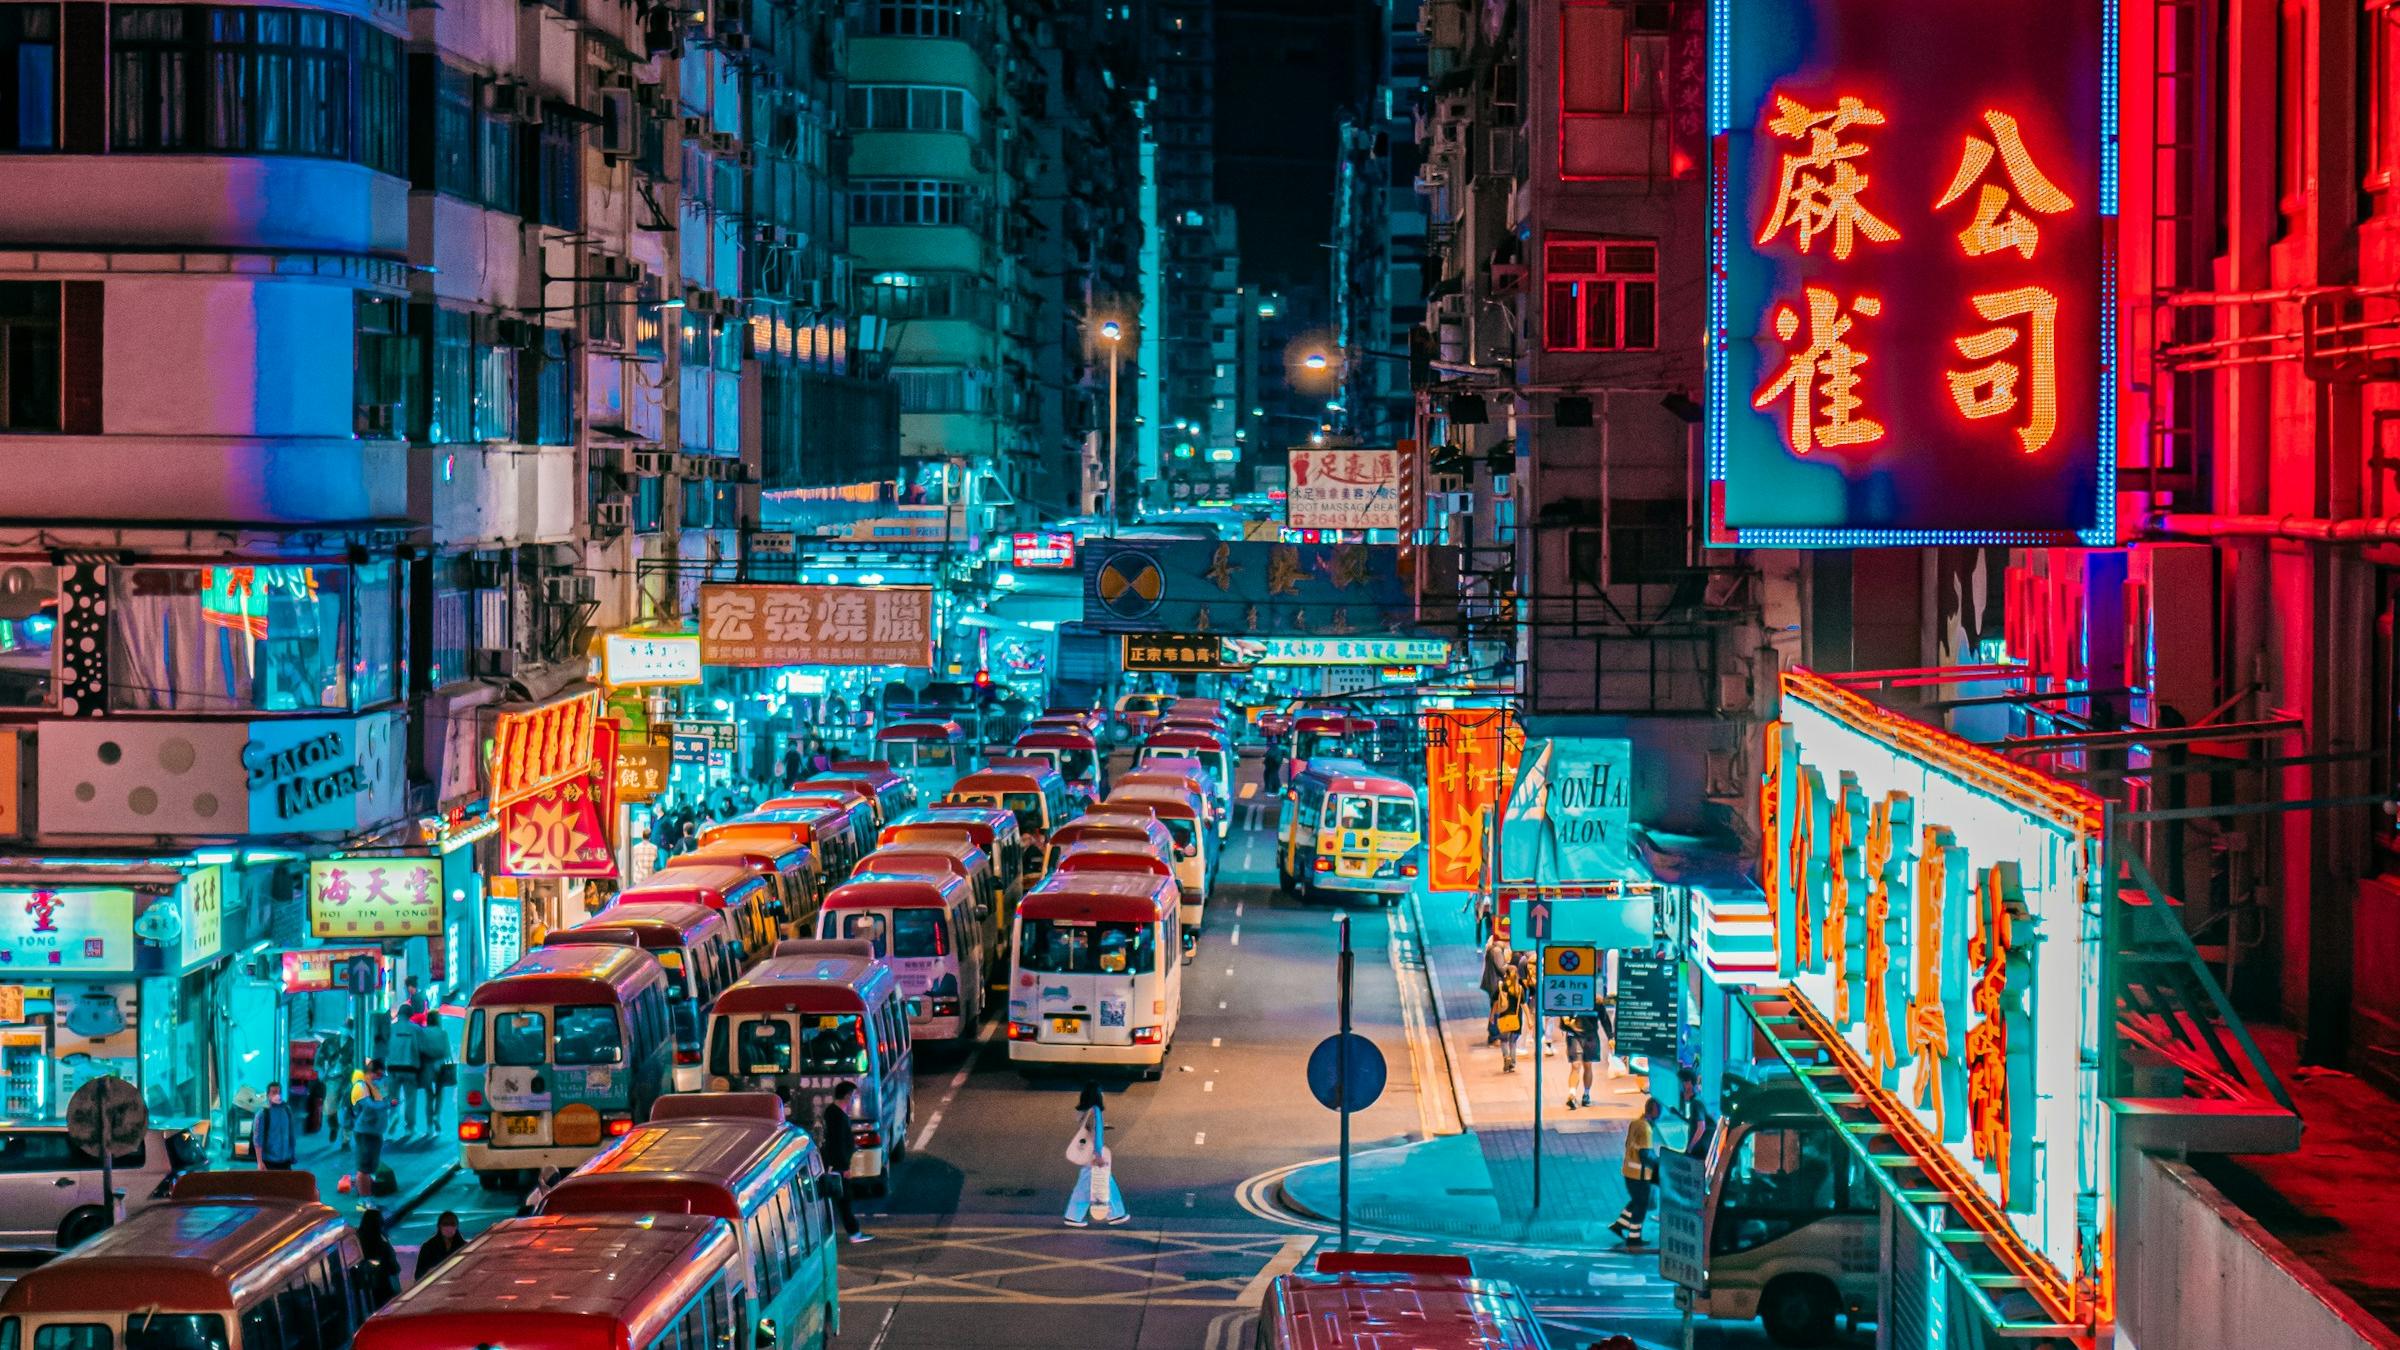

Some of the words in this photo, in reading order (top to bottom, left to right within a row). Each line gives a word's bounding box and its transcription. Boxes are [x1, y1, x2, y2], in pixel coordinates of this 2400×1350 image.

[1931, 109, 2076, 453] 公司
[1290, 503, 1319, 513] FOOT
[1321, 503, 1370, 513] MASSAGE
[1374, 502, 1398, 512] BEA
[1308, 514, 1347, 525] 2649
[706, 592, 924, 643] 宏發燒臘
[613, 767, 660, 789] 飩皇
[277, 765, 368, 819] MORE
[521, 820, 571, 859] 20
[1560, 819, 1608, 843] ALON
[317, 866, 439, 906] 海天堂
[24, 889, 65, 933] 堂
[358, 910, 377, 918] TIN
[395, 909, 428, 918] TONG
[17, 936, 57, 946] TONG
[1550, 979, 1566, 990] 24
[1569, 980, 1588, 990] hrs
[1553, 993, 1584, 1007] 全日
